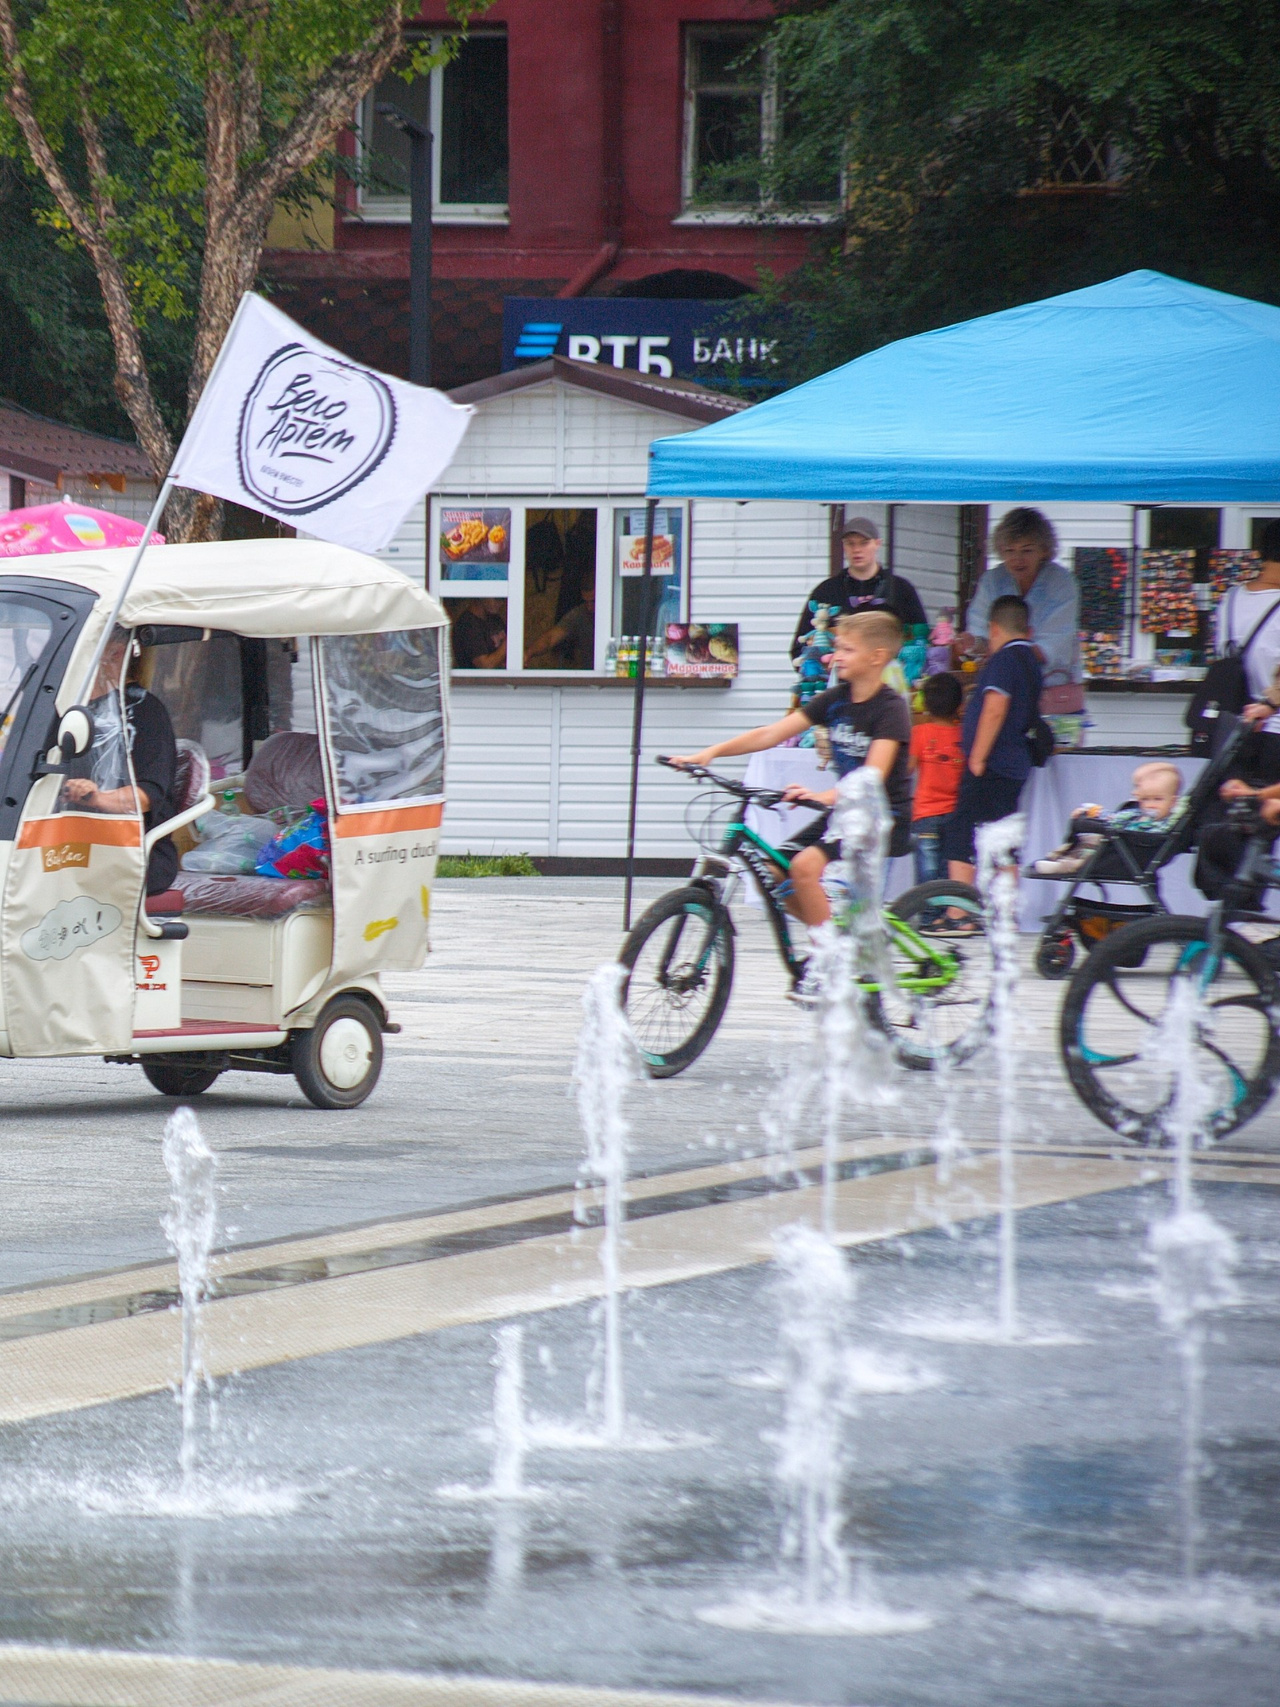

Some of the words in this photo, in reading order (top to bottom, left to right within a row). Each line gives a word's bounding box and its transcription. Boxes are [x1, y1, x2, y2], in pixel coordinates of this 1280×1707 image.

[693, 336, 780, 364] БАНК
[267, 373, 348, 420] Вело
[256, 409, 356, 457] Артём
[354, 849, 365, 865] A
